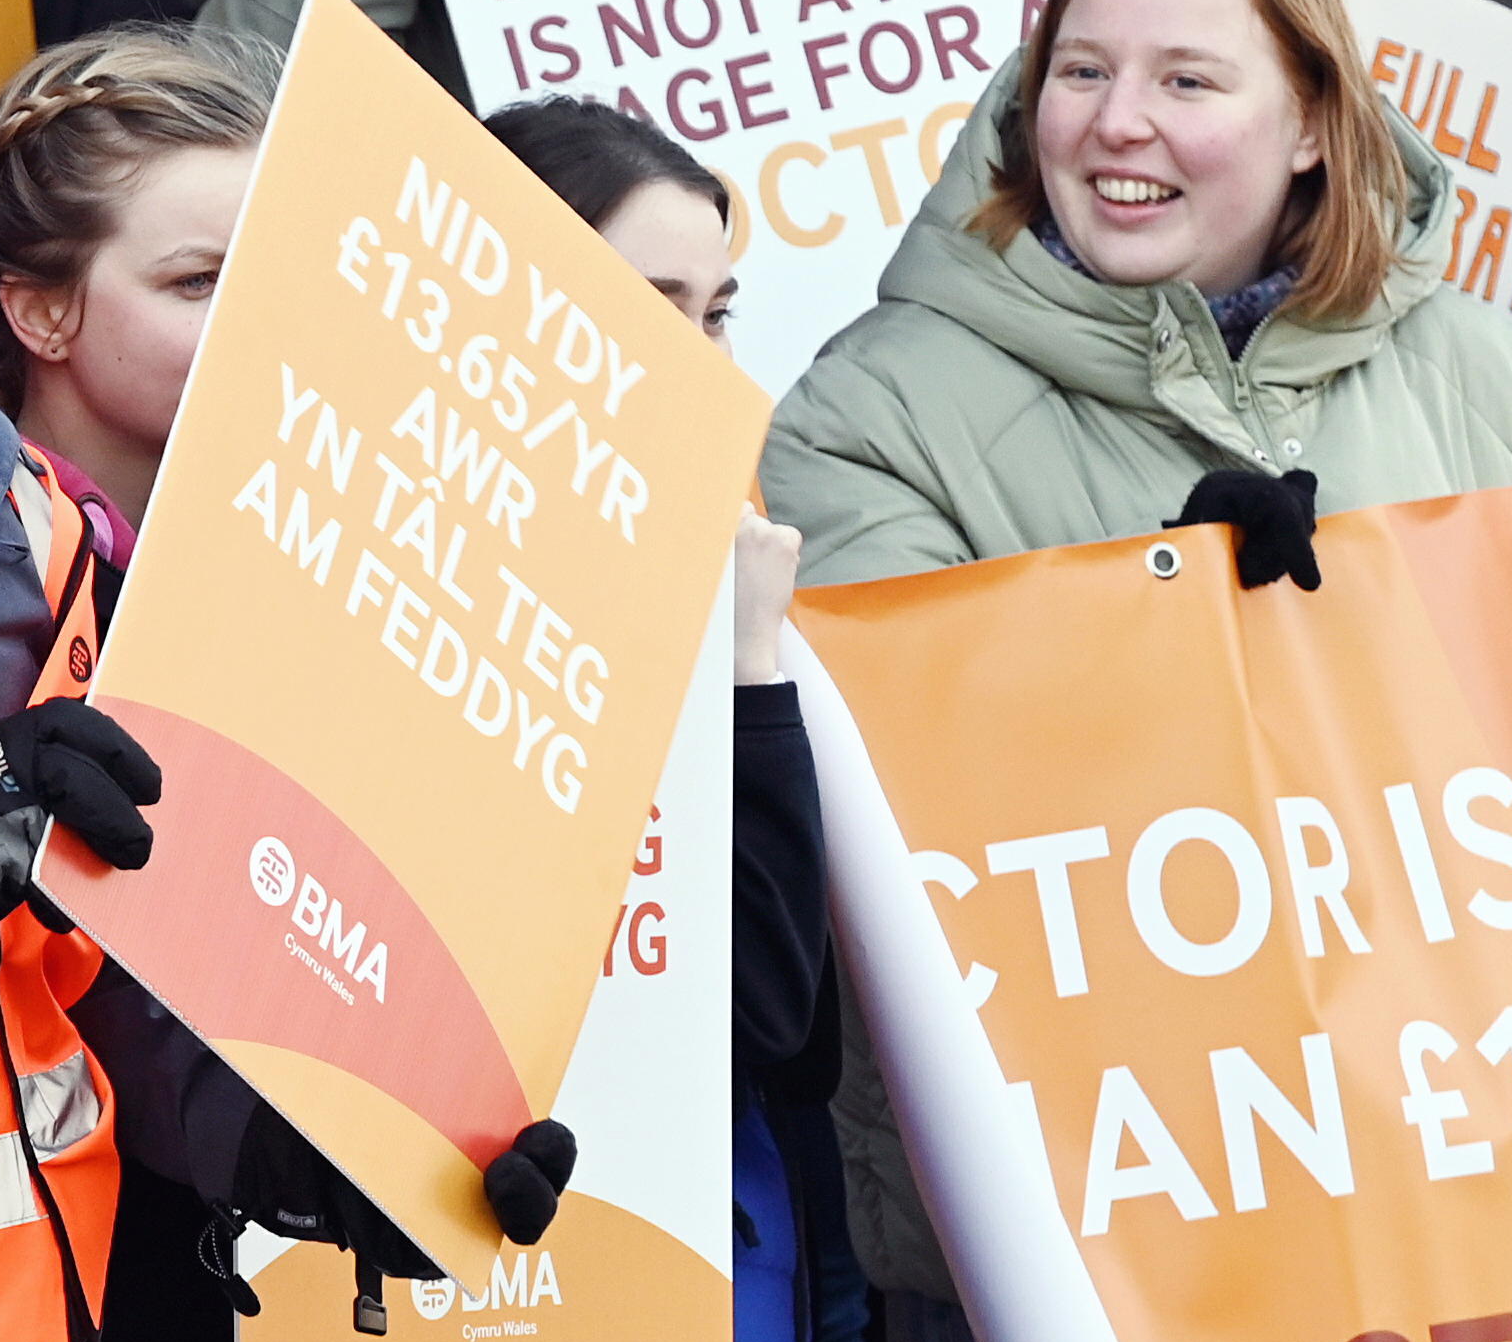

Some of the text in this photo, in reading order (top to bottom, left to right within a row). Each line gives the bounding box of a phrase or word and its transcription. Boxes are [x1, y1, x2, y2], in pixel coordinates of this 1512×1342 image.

[502, 16, 581, 90] IS
[803, 4, 992, 111] FOR
[1370, 37, 1502, 175] FULL
[396, 156, 645, 418] NID YDY
[336, 217, 650, 543] £13.65/YR
[392, 387, 537, 549] AWR
[277, 364, 611, 725] YN TÂL TEG
[232, 459, 589, 814] AM FEDDYG
[283, 932, 356, 1007] Cymru Wales
[291, 874, 387, 1004] BMA
[462, 1319, 538, 1342] Cymru Wales
